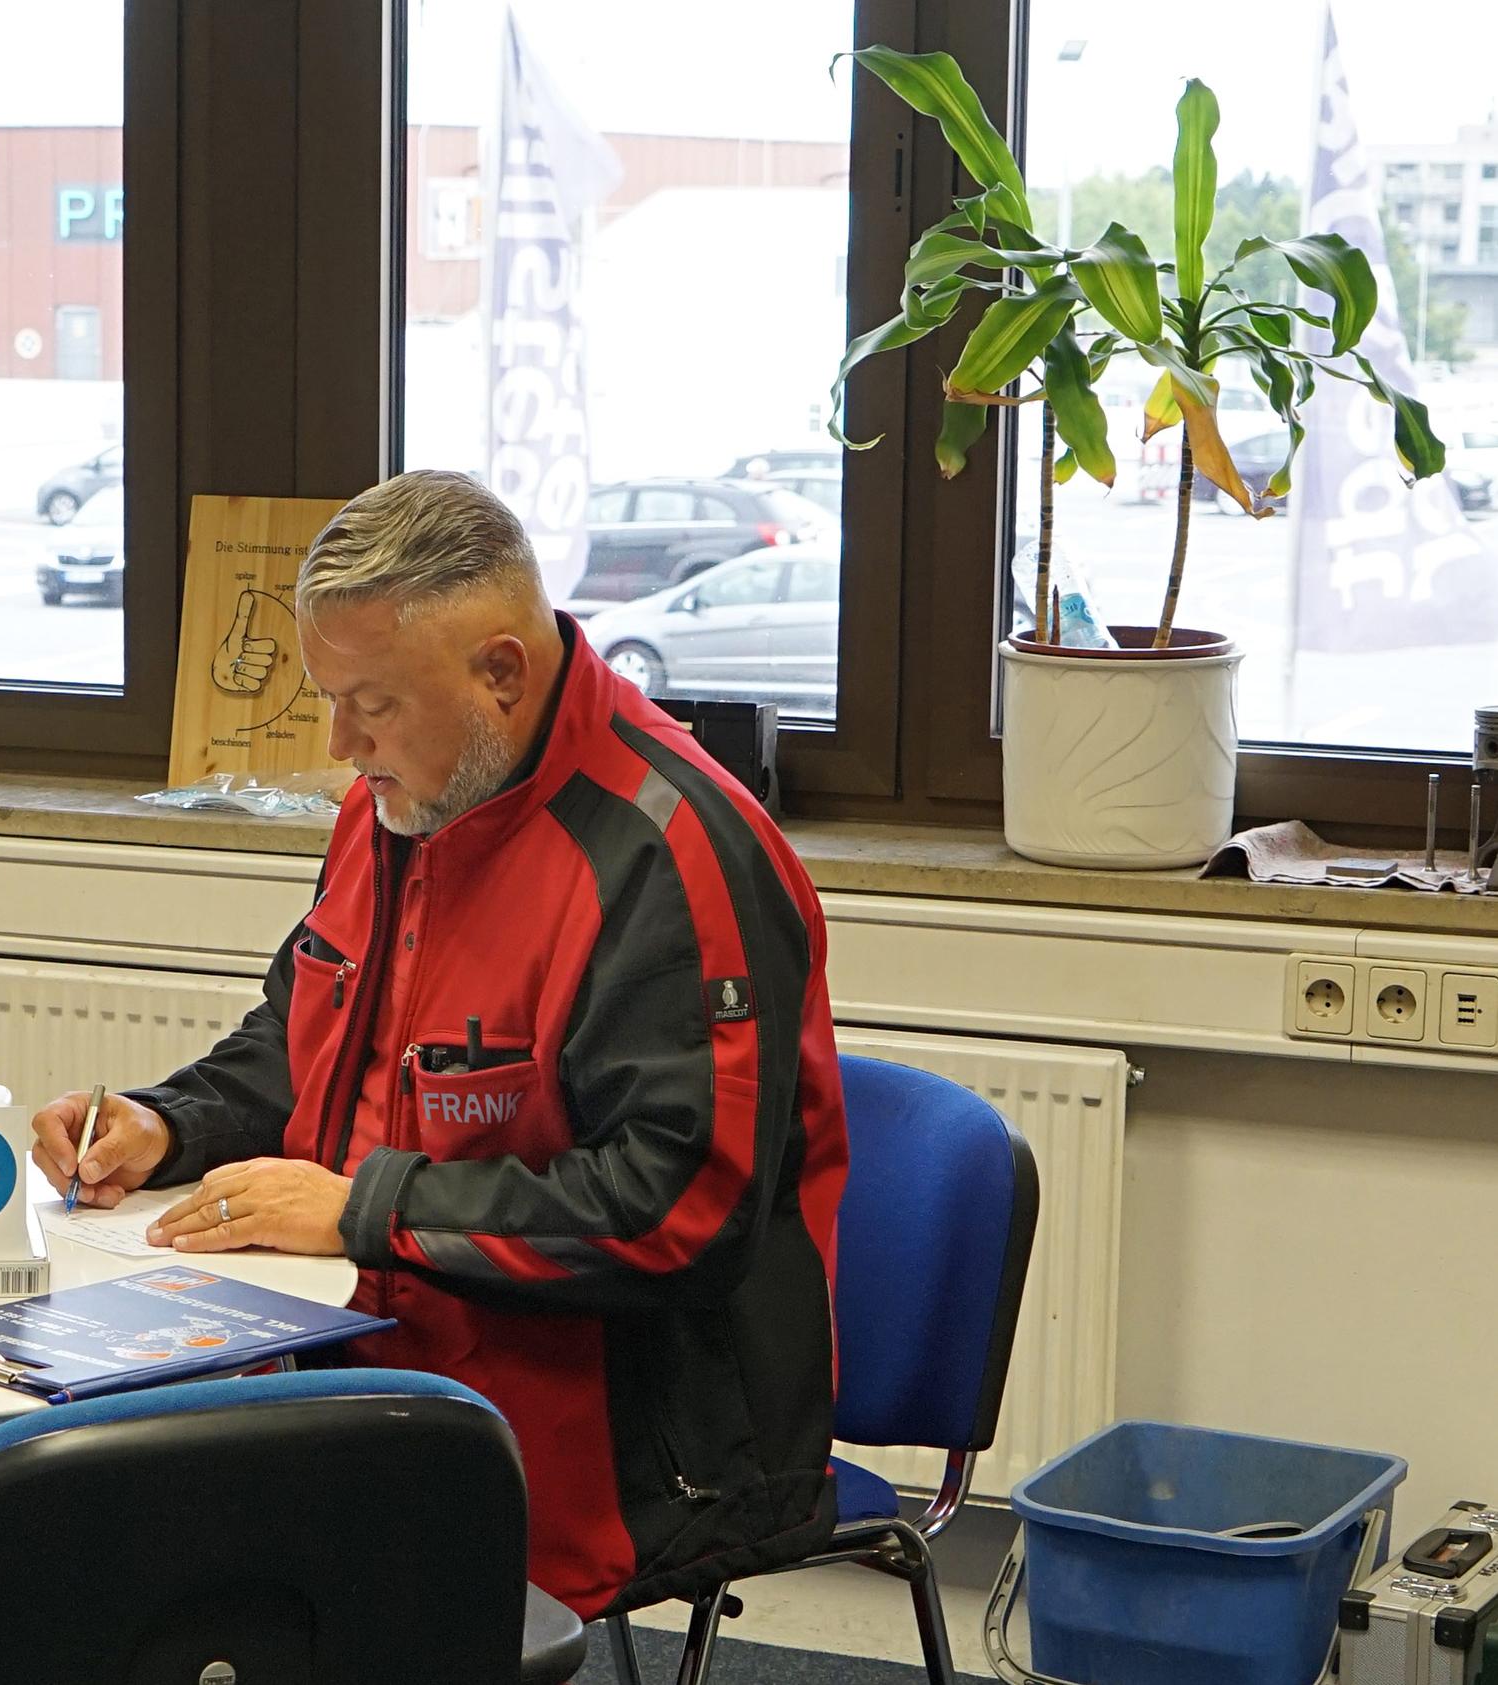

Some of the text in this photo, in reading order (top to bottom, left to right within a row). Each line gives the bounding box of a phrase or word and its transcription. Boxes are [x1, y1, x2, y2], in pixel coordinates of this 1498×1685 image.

[215, 541, 308, 556] Die Stimmung ist
[715, 1008, 748, 1019] MASCOT
[422, 1092, 524, 1124] FRANK
[112, 1279, 262, 1321] BAUMASCHINEN
